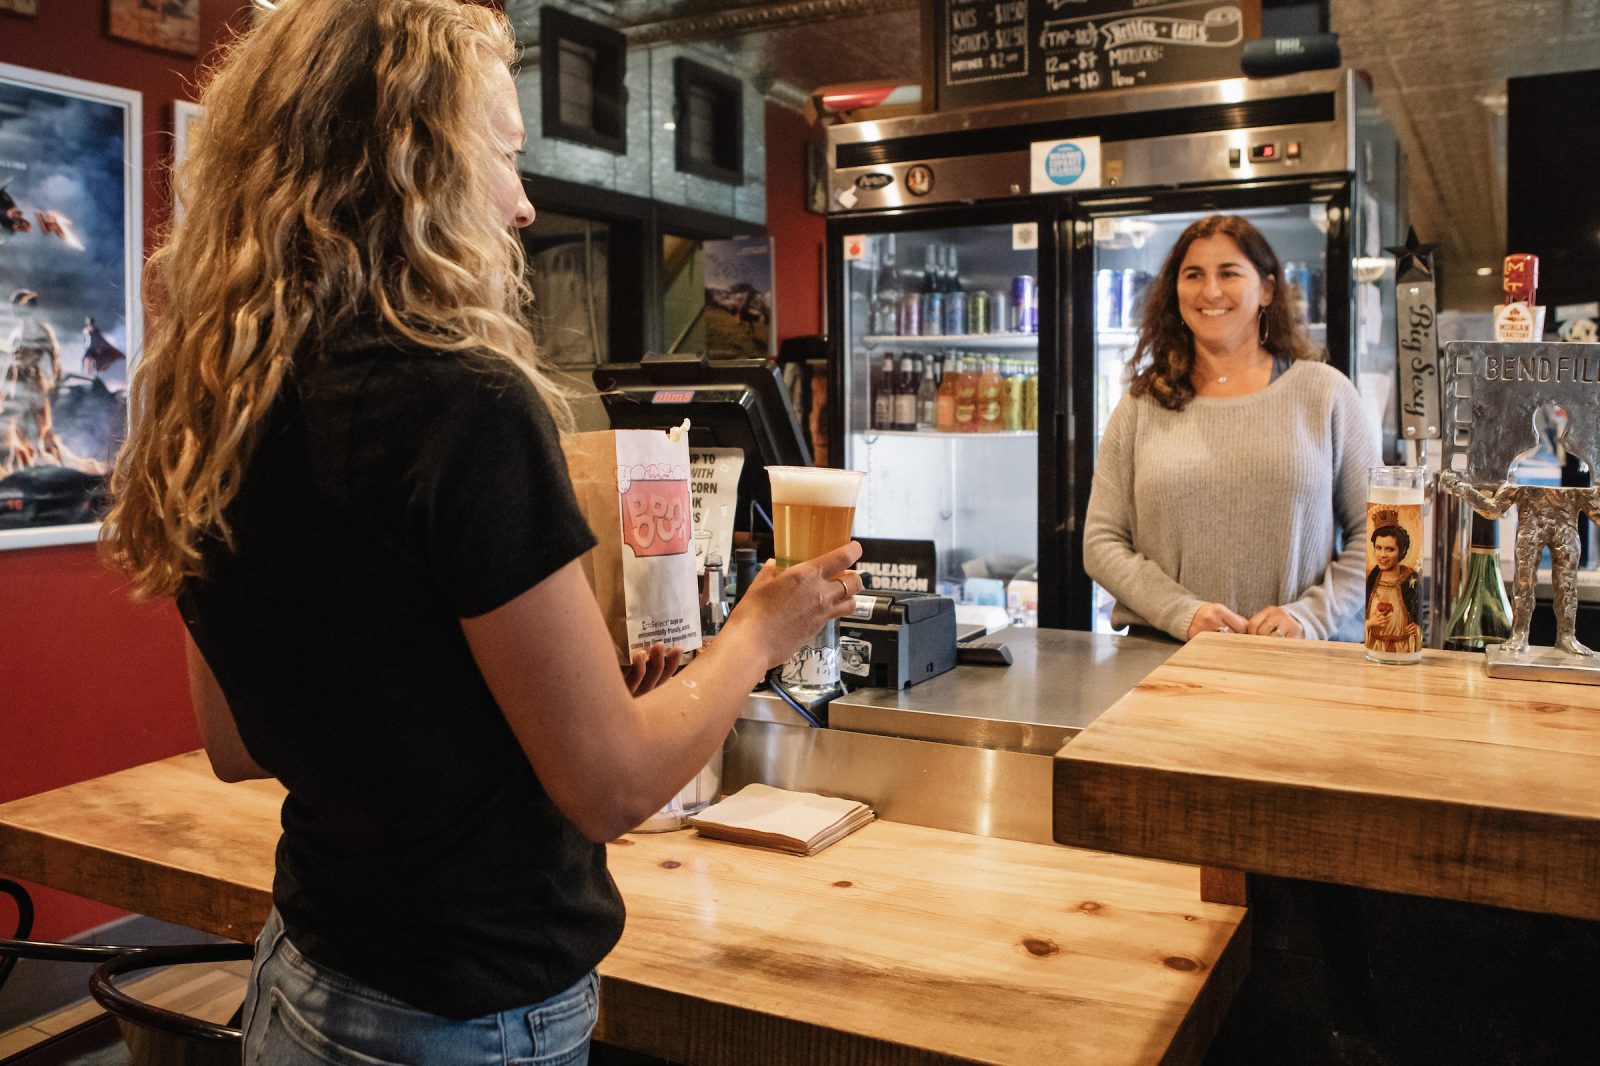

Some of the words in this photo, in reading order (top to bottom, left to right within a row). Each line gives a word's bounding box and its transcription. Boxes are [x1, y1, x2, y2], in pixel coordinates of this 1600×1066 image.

[1402, 303, 1434, 352] Big
[1485, 355, 1600, 384] BENDFIL
[1403, 356, 1436, 417] Sexy
[702, 453, 716, 465] TO
[871, 576, 929, 592] DRAGON
